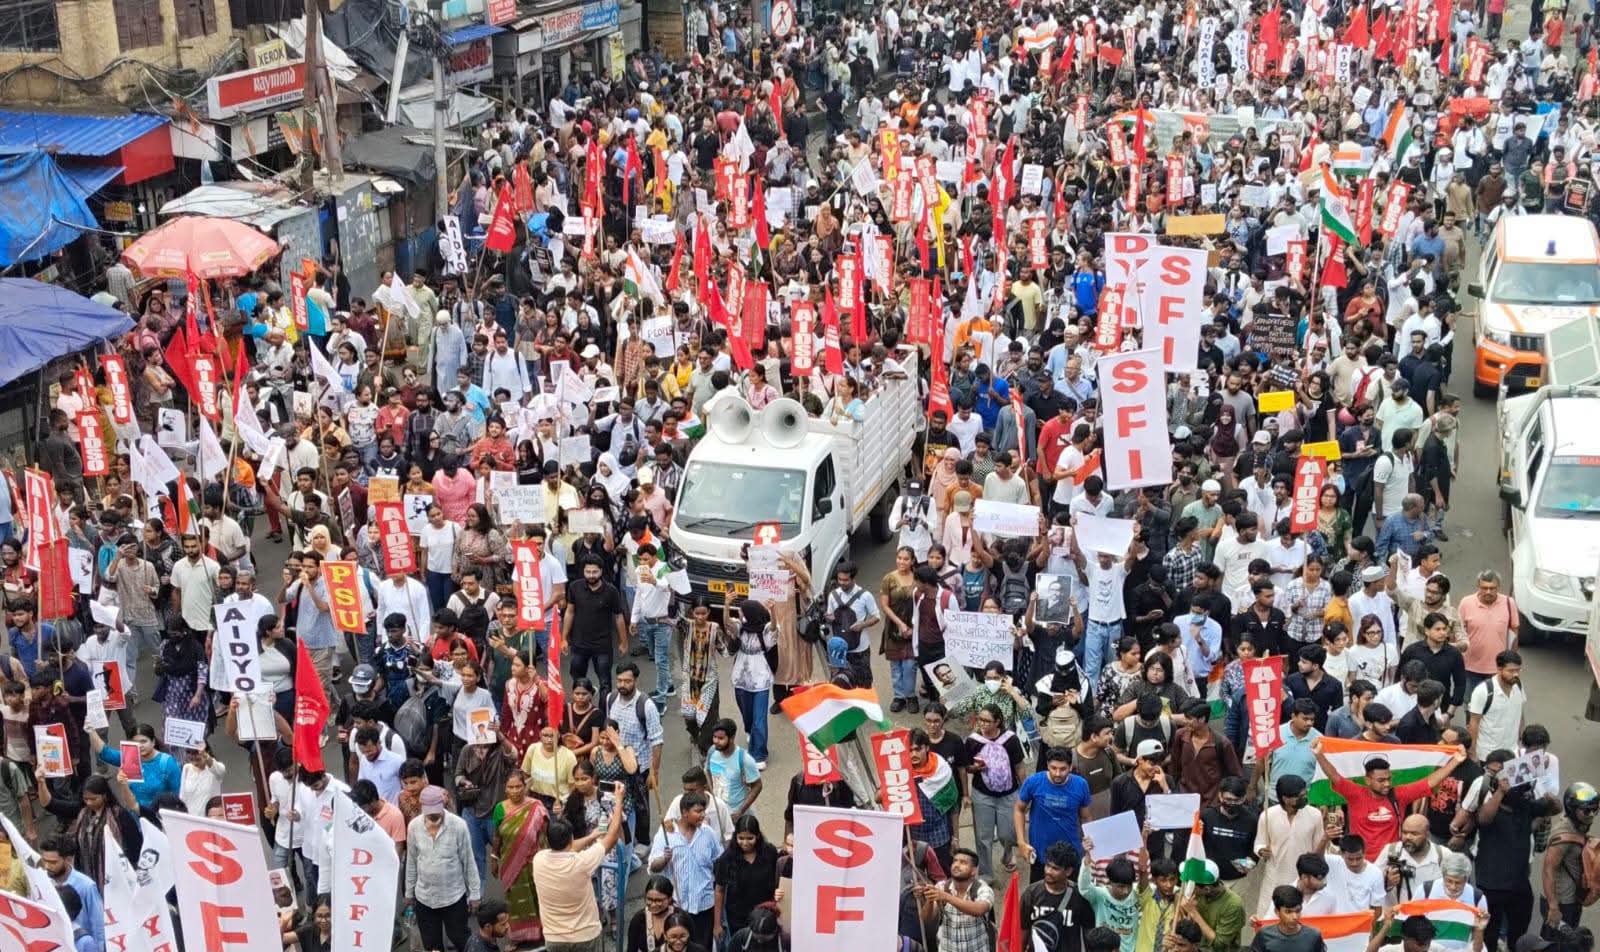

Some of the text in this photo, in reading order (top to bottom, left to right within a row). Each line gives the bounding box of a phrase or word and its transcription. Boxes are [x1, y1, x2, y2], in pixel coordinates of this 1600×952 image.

[254, 66, 296, 95] Raymond
[258, 47, 284, 65] XEROX
[882, 131, 897, 182] RYA
[1383, 185, 1406, 231] AIDSO
[449, 220, 465, 271] AIDYO
[840, 259, 855, 308] AIDSO
[1159, 256, 1191, 364] SFI
[794, 309, 812, 368] AIDSO
[1098, 291, 1121, 345] AIDSO
[106, 360, 128, 418] AIDSO
[195, 359, 217, 415] AIDSO
[81, 415, 104, 472] AIDSO
[1112, 360, 1149, 481] SFI
[1295, 461, 1321, 525] AIDSO
[382, 507, 412, 569] AIDSO
[328, 566, 359, 628] PSU
[517, 547, 541, 621] AIDSO
[224, 607, 255, 692] AIDYO
[1250, 667, 1277, 749] AIDSO
[880, 738, 915, 818] AIDSO
[349, 848, 374, 947] DYFI
[812, 819, 874, 935] SF
